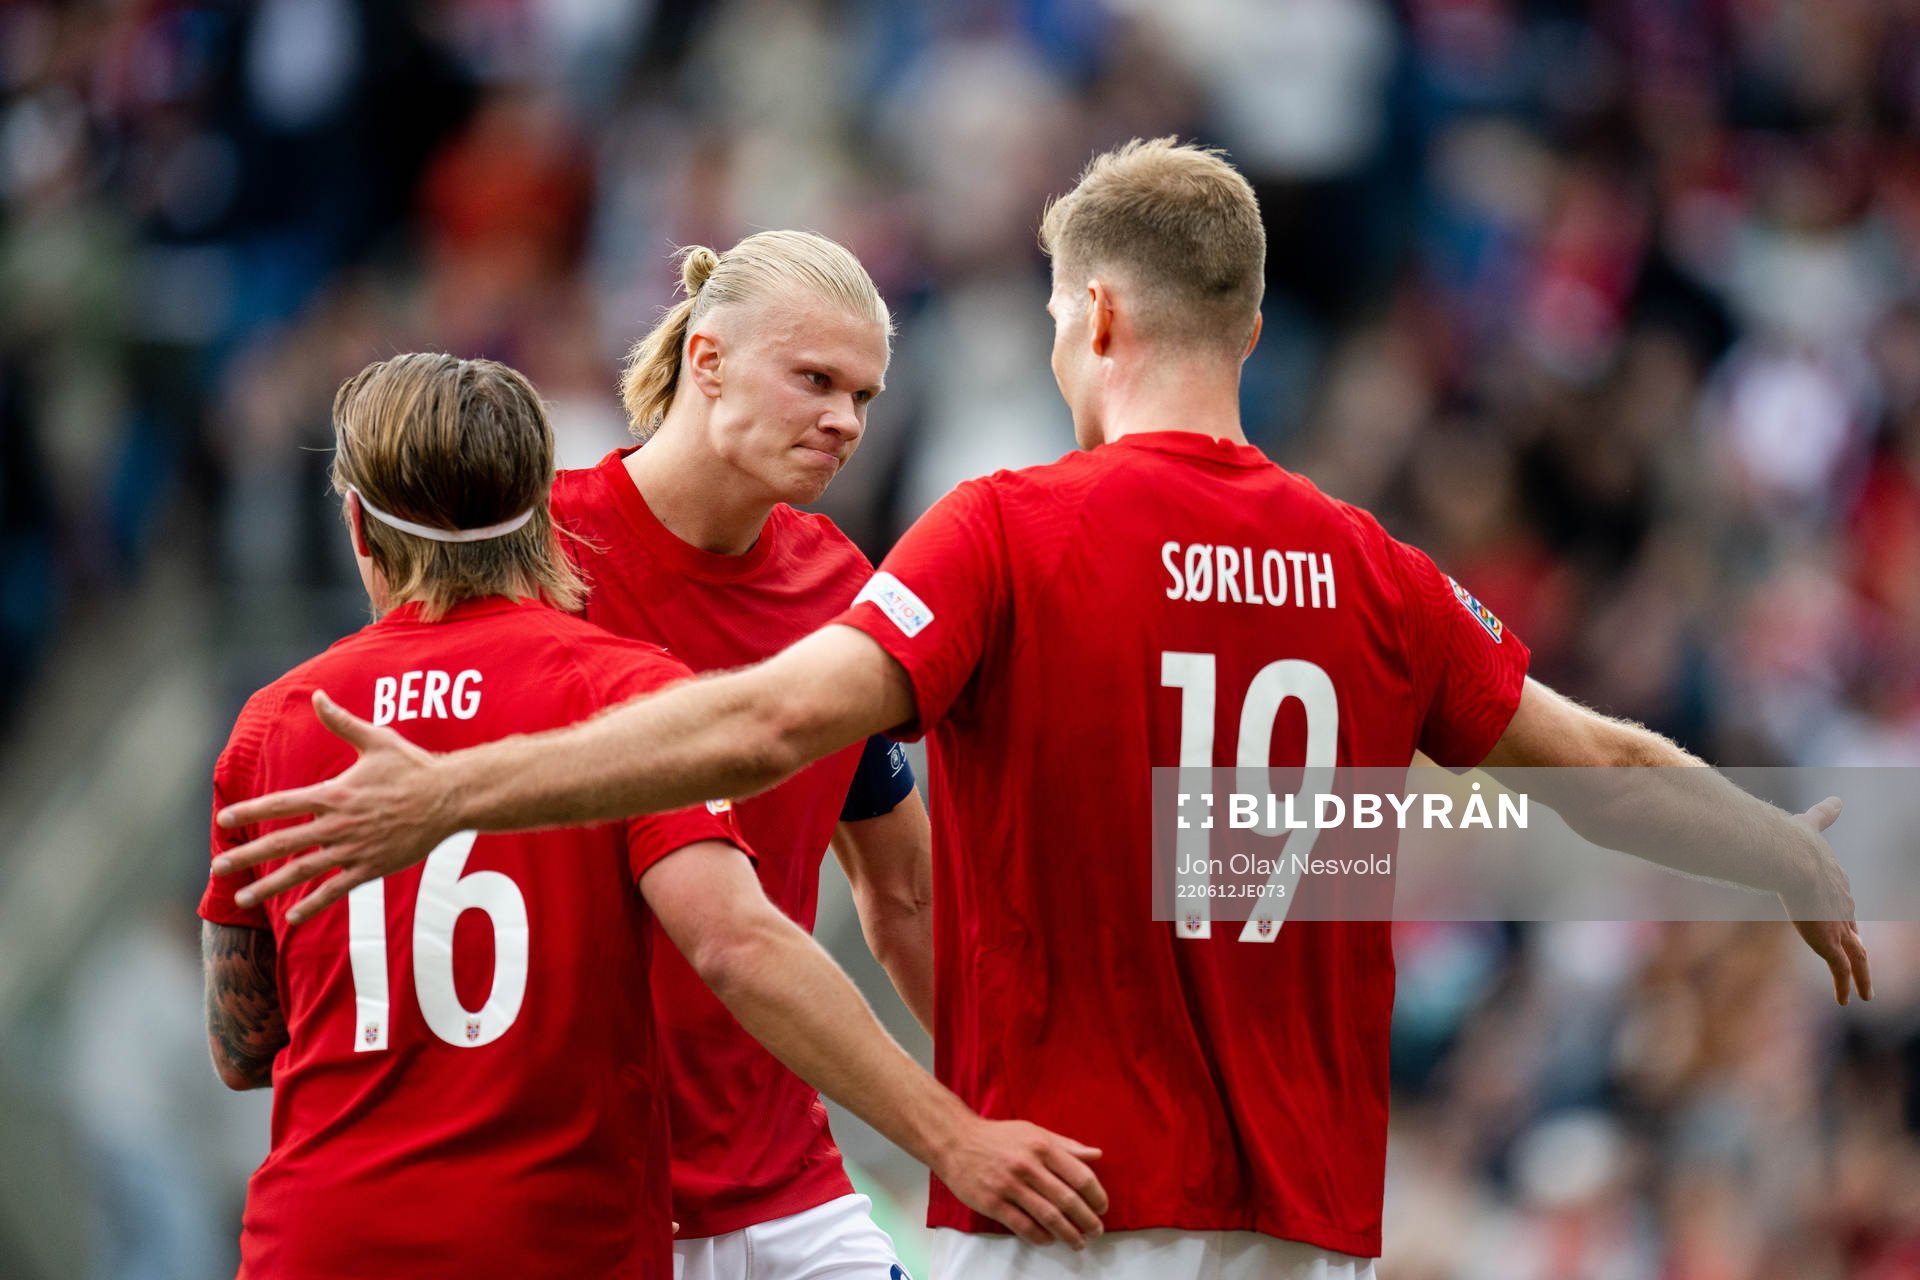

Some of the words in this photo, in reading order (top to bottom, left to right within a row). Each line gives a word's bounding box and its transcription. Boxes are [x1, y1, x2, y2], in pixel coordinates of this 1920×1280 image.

[1161, 541, 1336, 608] SØRLOTH
[373, 669, 483, 726] BERG
[1161, 651, 1338, 942] 19
[348, 829, 529, 1052] 16
